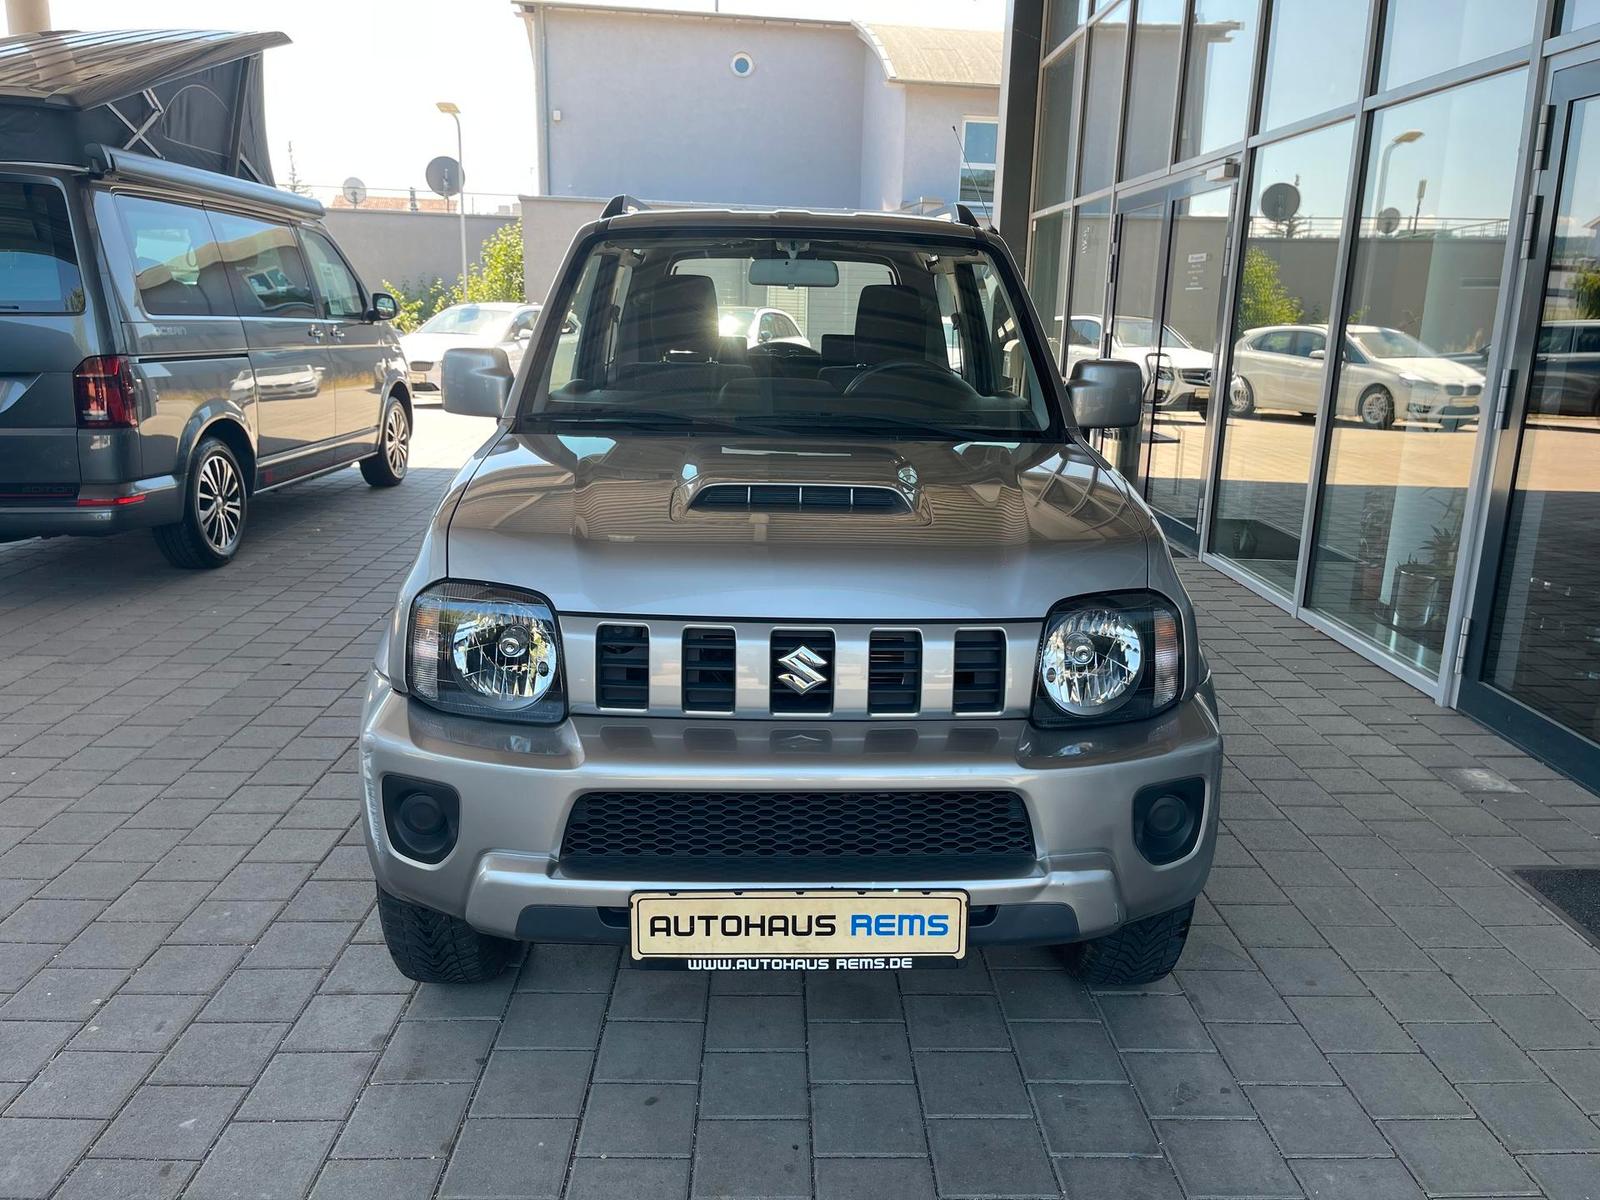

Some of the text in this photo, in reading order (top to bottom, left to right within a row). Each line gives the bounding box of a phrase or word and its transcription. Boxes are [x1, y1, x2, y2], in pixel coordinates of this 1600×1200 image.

[649, 914, 949, 937] AUTOHAUS REMS
[687, 957, 913, 970] WWW.AUTOHAUS REMS.DE
